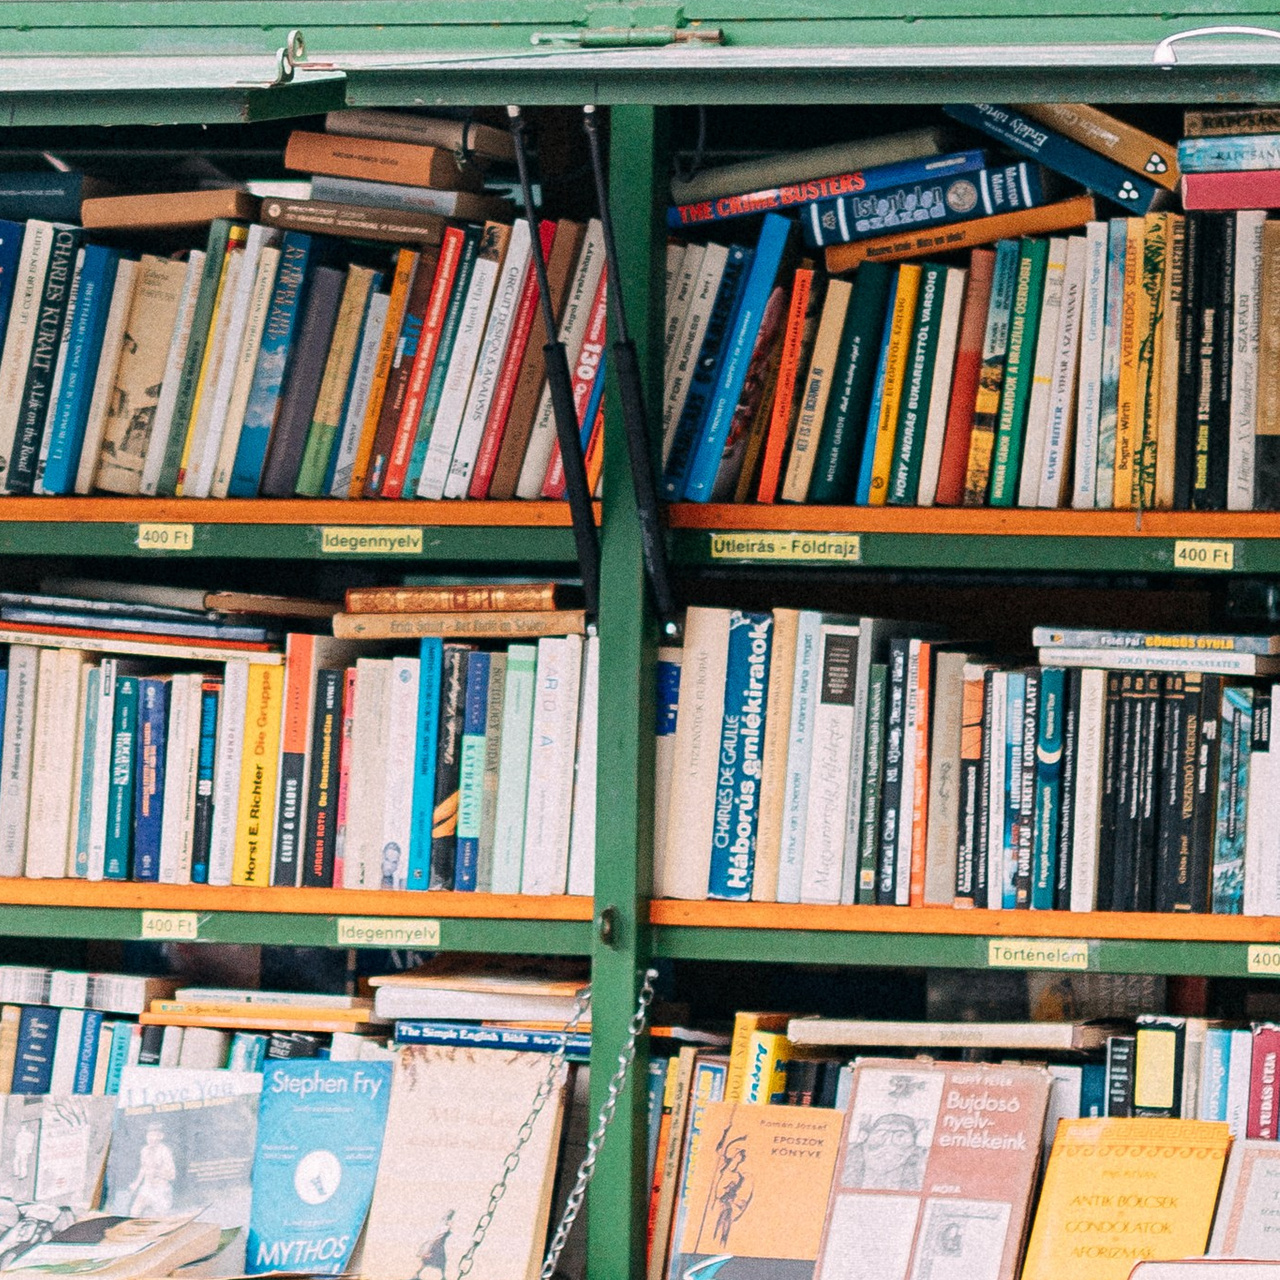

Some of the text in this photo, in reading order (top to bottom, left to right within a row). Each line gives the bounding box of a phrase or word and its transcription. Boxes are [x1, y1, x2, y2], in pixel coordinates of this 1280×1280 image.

[1008, 116, 1048, 148] Erdély
[677, 200, 713, 225] THE
[778, 169, 865, 206] BUSTERS
[851, 179, 944, 223] Istentelen
[854, 200, 945, 235] század
[669, 280, 709, 401] FOR BUSINESS Part
[1237, 294, 1249, 353] SZAFÁRI
[17, 230, 73, 472] CHARLES KURALT A Life on the Road
[472, 266, 519, 422] CIRCUIT DESIGN & ANALYSIS
[576, 341, 601, 380] 130
[900, 412, 916, 461] ANDRÁS
[920, 270, 938, 321] VARSÓIG
[1000, 377, 1016, 429] KALANDOK
[1051, 406, 1061, 445] BUTLER
[1047, 449, 1056, 480] MARY
[142, 530, 190, 545] 400 Ft
[325, 533, 420, 550] Idegennyelv
[792, 539, 856, 557] Földrajz
[1179, 546, 1231, 564] 400 Ft
[1145, 636, 1233, 648] GÖMBÖS GYULA
[1026, 678, 1036, 714] ALATT
[11, 671, 27, 780] Német nyelvkönyv
[486, 667, 502, 773] SOCIOLOGY TODAY
[727, 623, 772, 889] Háborús emlékiratok
[1023, 718, 1035, 765] LOBOGÓ
[246, 670, 272, 881] Horst E. Richter Die Gruppe
[714, 715, 739, 848] CHARLES DE GAULLE
[1022, 772, 1032, 814] FEKETE
[1181, 764, 1194, 818] VESZENDŐ
[281, 778, 298, 862] ELVIS GLADYS
[316, 812, 325, 836] ROTH
[312, 839, 324, 876] JÜRGEN
[147, 919, 193, 934] 400 Ft
[341, 924, 438, 941] Idegennyelv
[994, 946, 1087, 963] Történelem
[81, 1014, 97, 1060] FOUNDATION
[399, 1025, 419, 1036] The
[423, 1027, 456, 1040] Simple
[460, 1030, 497, 1043] English
[502, 1033, 527, 1043] Bible
[139, 1085, 188, 1105] Love
[272, 1070, 382, 1100] Stephen Fry
[946, 1091, 1019, 1114] Bujdosó
[1260, 1051, 1276, 1127] TUDÁS ÚTJA
[943, 1112, 996, 1131] nyelv-
[771, 1147, 822, 1159] KÖNYVE
[773, 1136, 824, 1147] EPOSZOK
[938, 1129, 1028, 1152] emlékeink
[1070, 1196, 1115, 1209] ANTIK
[256, 1236, 349, 1266] MYTHOS
